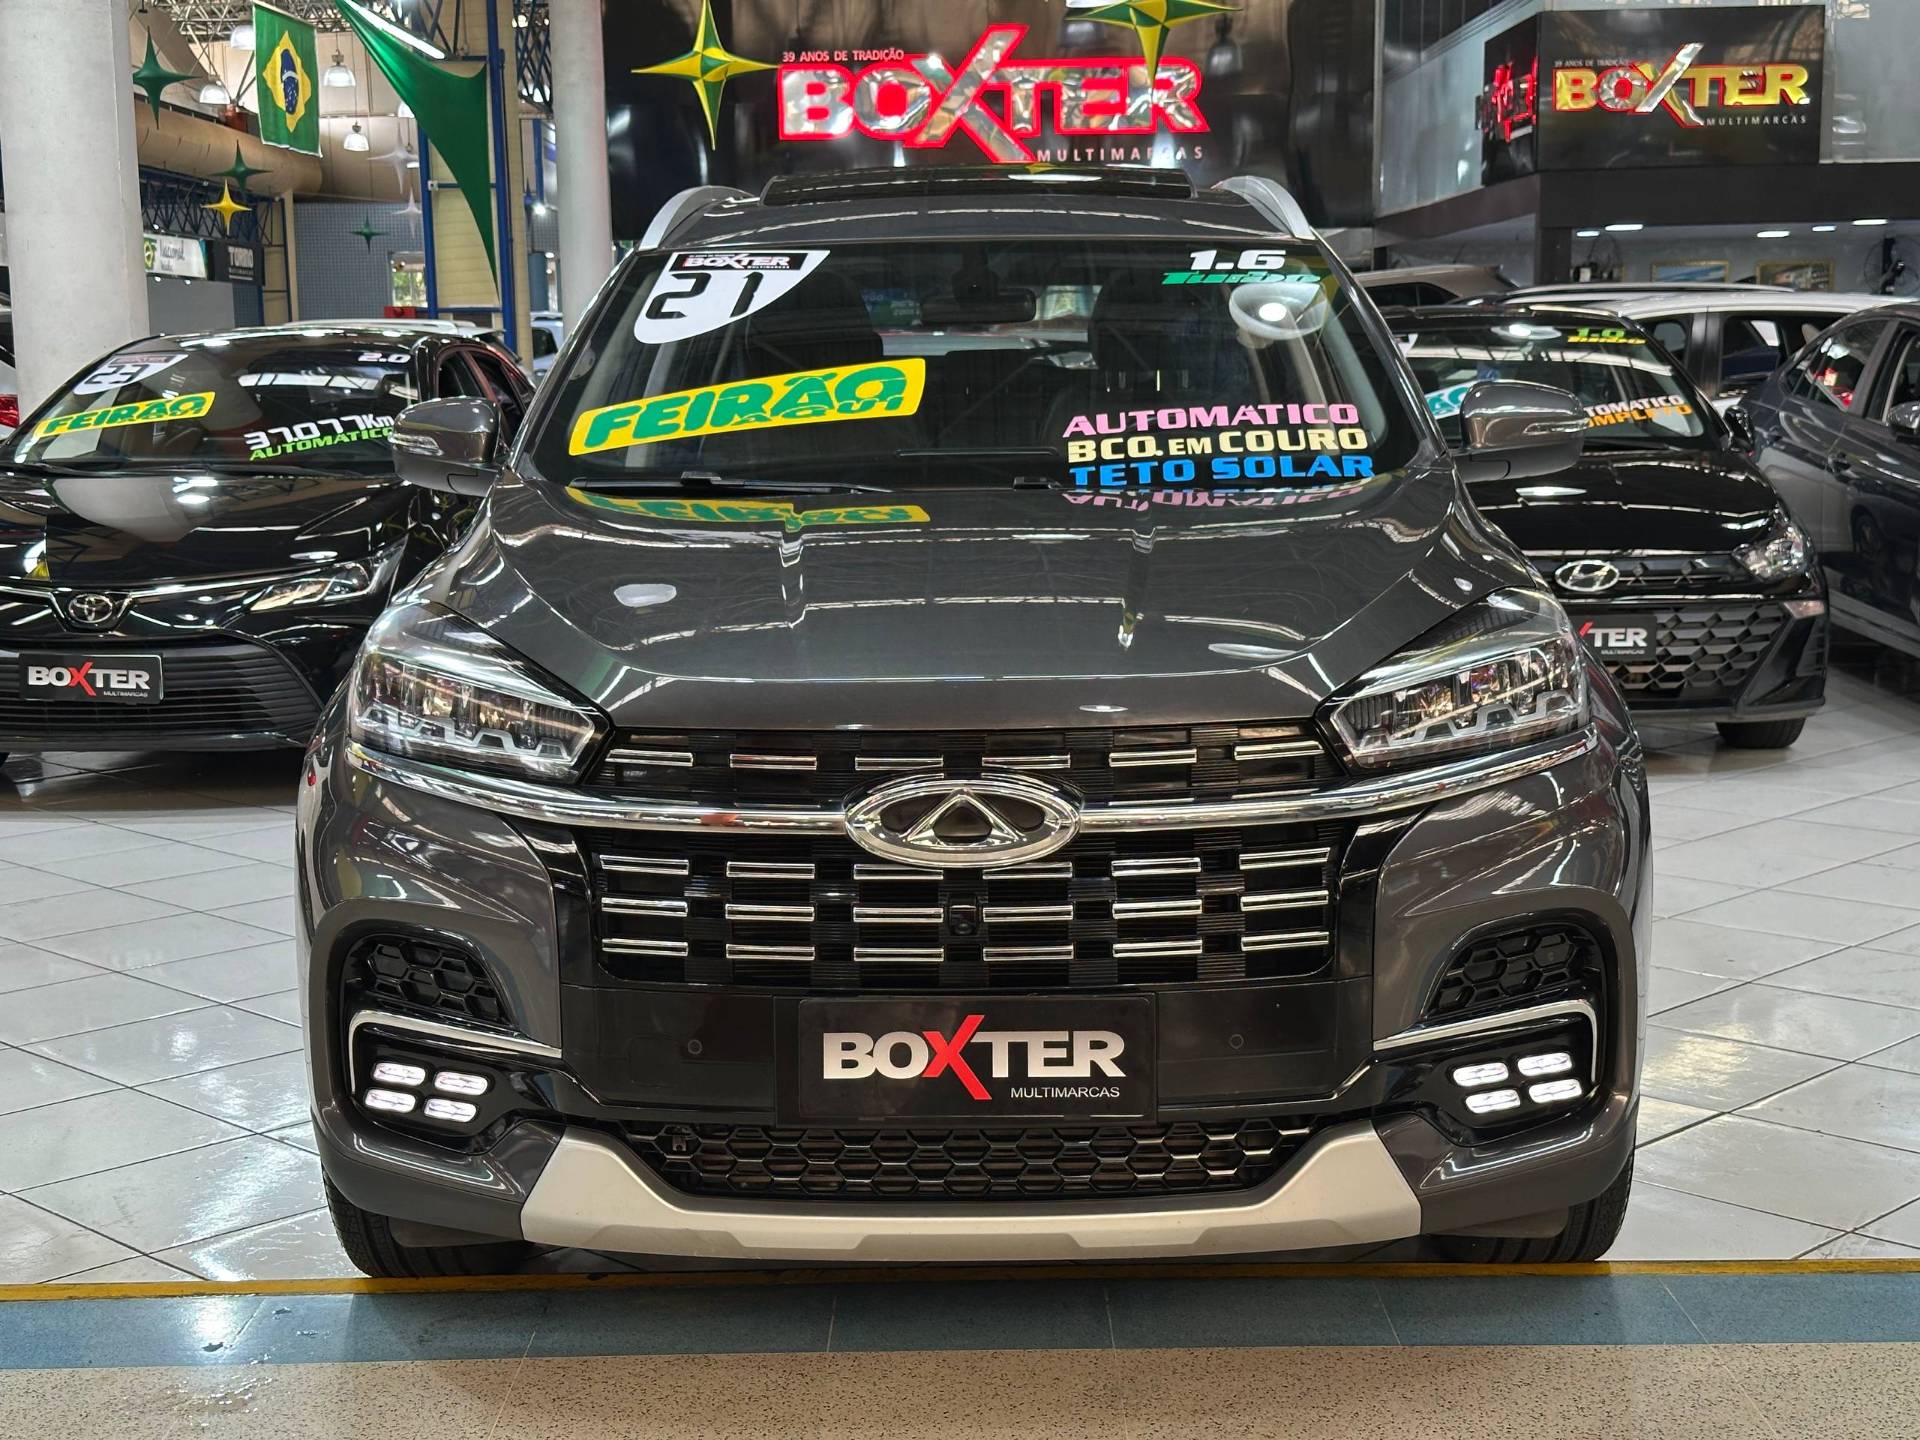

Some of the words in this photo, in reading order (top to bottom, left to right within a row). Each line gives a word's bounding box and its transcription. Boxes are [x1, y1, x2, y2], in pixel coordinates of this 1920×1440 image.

[782, 51, 796, 63] 39
[800, 50, 830, 62] ANOS
[834, 50, 848, 61] DE
[853, 47, 904, 62] TRADIÇÃO
[777, 23, 1211, 164] BOXTER
[1554, 42, 1811, 129] BOXTER
[1706, 116, 1807, 127] MULTIMARCAS
[682, 253, 791, 269] BOXTER
[1189, 249, 1287, 271] 1.6
[645, 271, 764, 320] 21
[357, 352, 412, 364] 2.0
[583, 365, 908, 449] FEIRÃO
[1168, 436, 1212, 456] EM
[1218, 427, 1370, 454] COURO
[1069, 458, 1196, 487] TETO
[1211, 455, 1376, 480] SOLAR
[27, 661, 151, 696] BOXTER
[822, 1014, 1127, 1101] BOXTER
[1010, 1086, 1121, 1099] MULTIMARCAS
